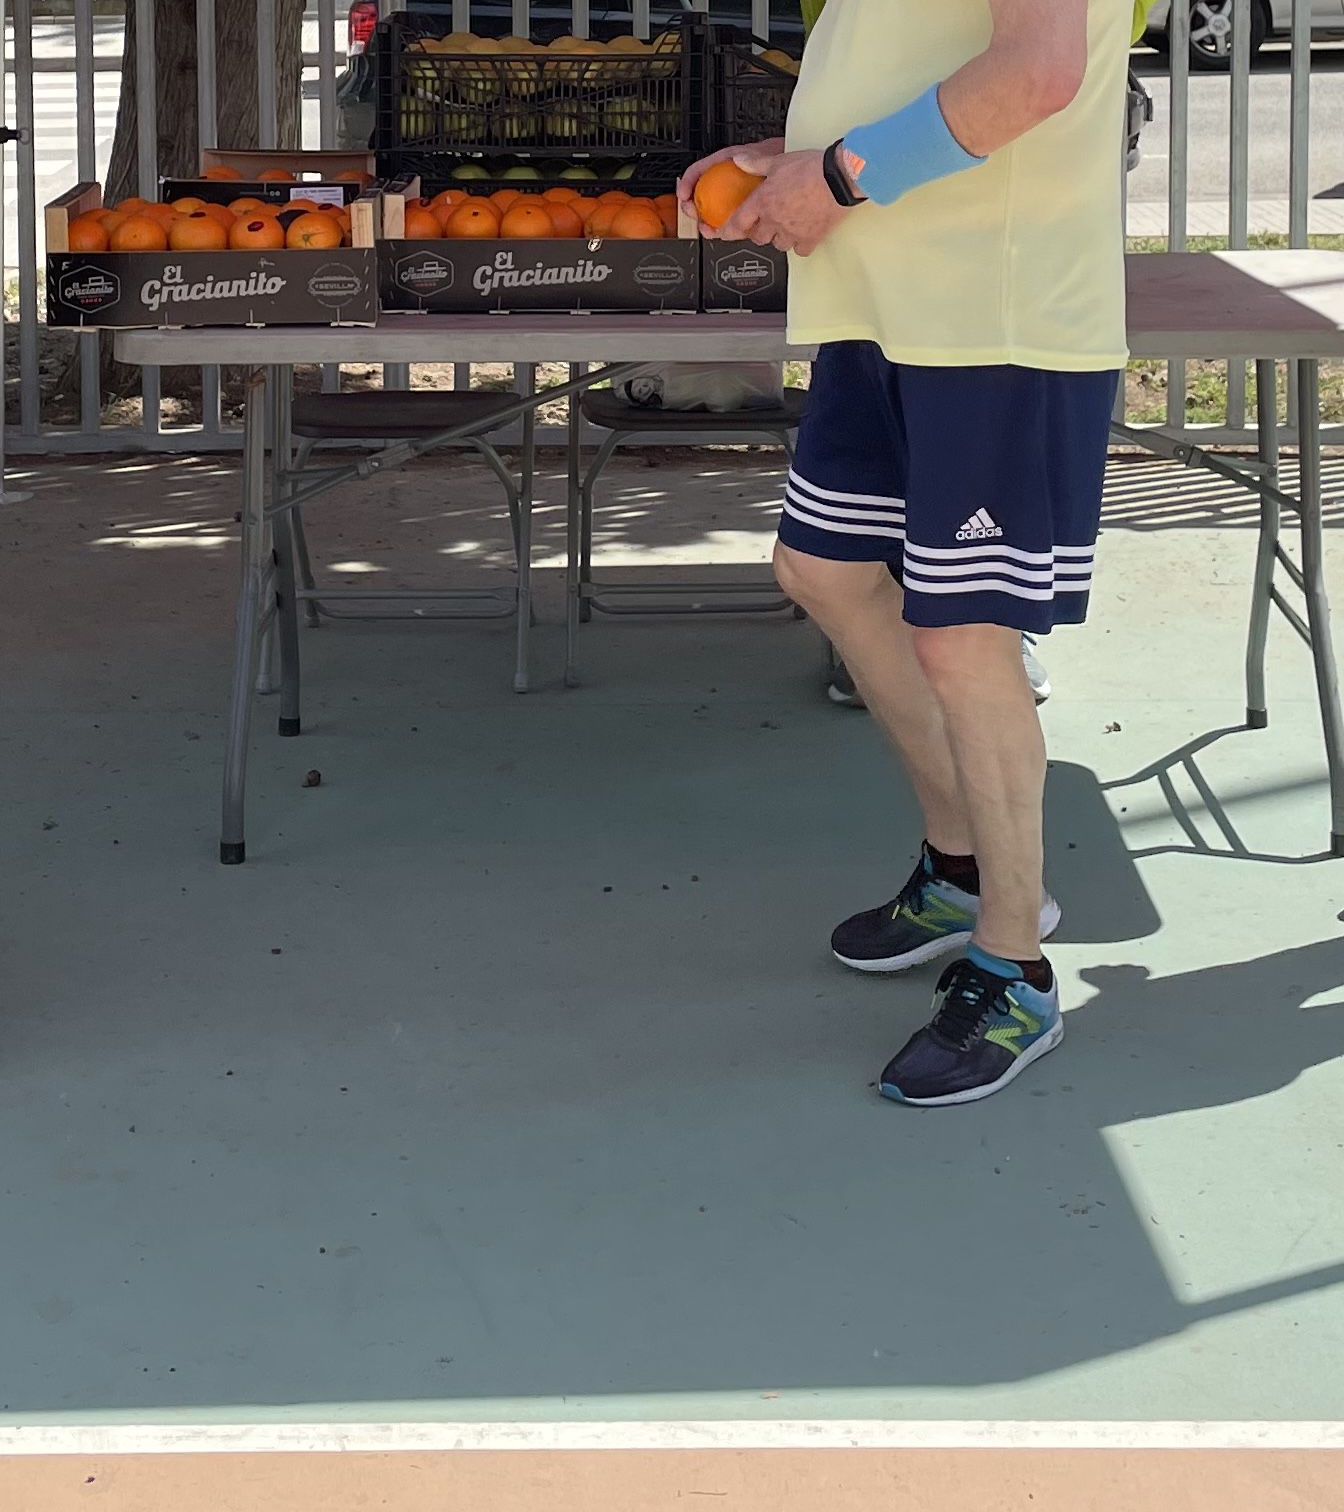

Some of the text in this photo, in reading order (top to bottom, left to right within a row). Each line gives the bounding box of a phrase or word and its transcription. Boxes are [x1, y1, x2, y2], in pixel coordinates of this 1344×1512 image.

[494, 251, 515, 270] El
[162, 265, 185, 284] El
[472, 259, 613, 297] Gracianito
[140, 272, 287, 311] Gracianito
[955, 527, 1003, 541] adidas
